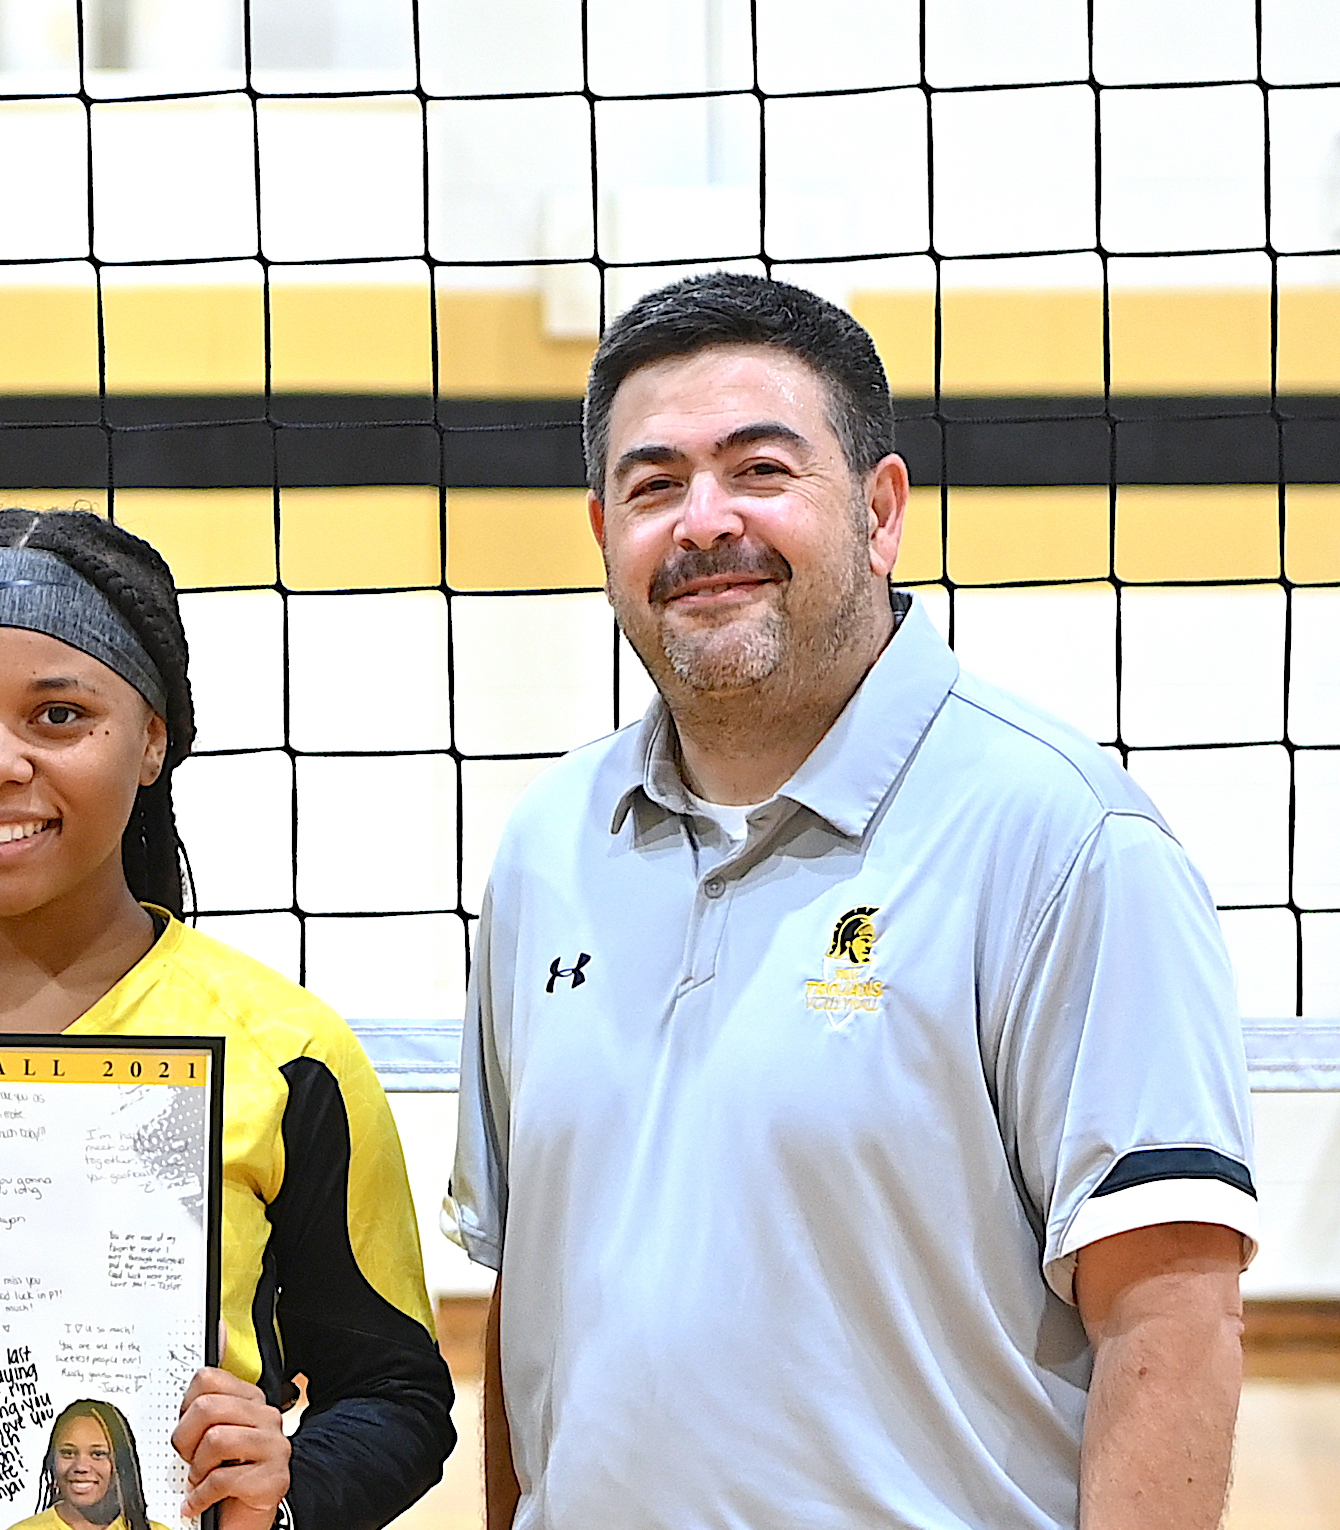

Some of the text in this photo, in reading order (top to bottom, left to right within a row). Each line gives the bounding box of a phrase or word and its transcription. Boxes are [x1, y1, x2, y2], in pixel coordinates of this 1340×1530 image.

[805, 980, 884, 997] TROJANS
[103, 1060, 197, 1080] 2021
[17, 1177, 52, 1193] gonna
[14, 1187, 42, 1200] long
[3, 1277, 22, 1285] miss
[25, 1278, 41, 1288] you
[15, 1291, 34, 1300] luck
[7, 1345, 32, 1367] last
[92, 1356, 118, 1366] people
[24, 1392, 52, 1412] you
[30, 1408, 54, 1429] you
